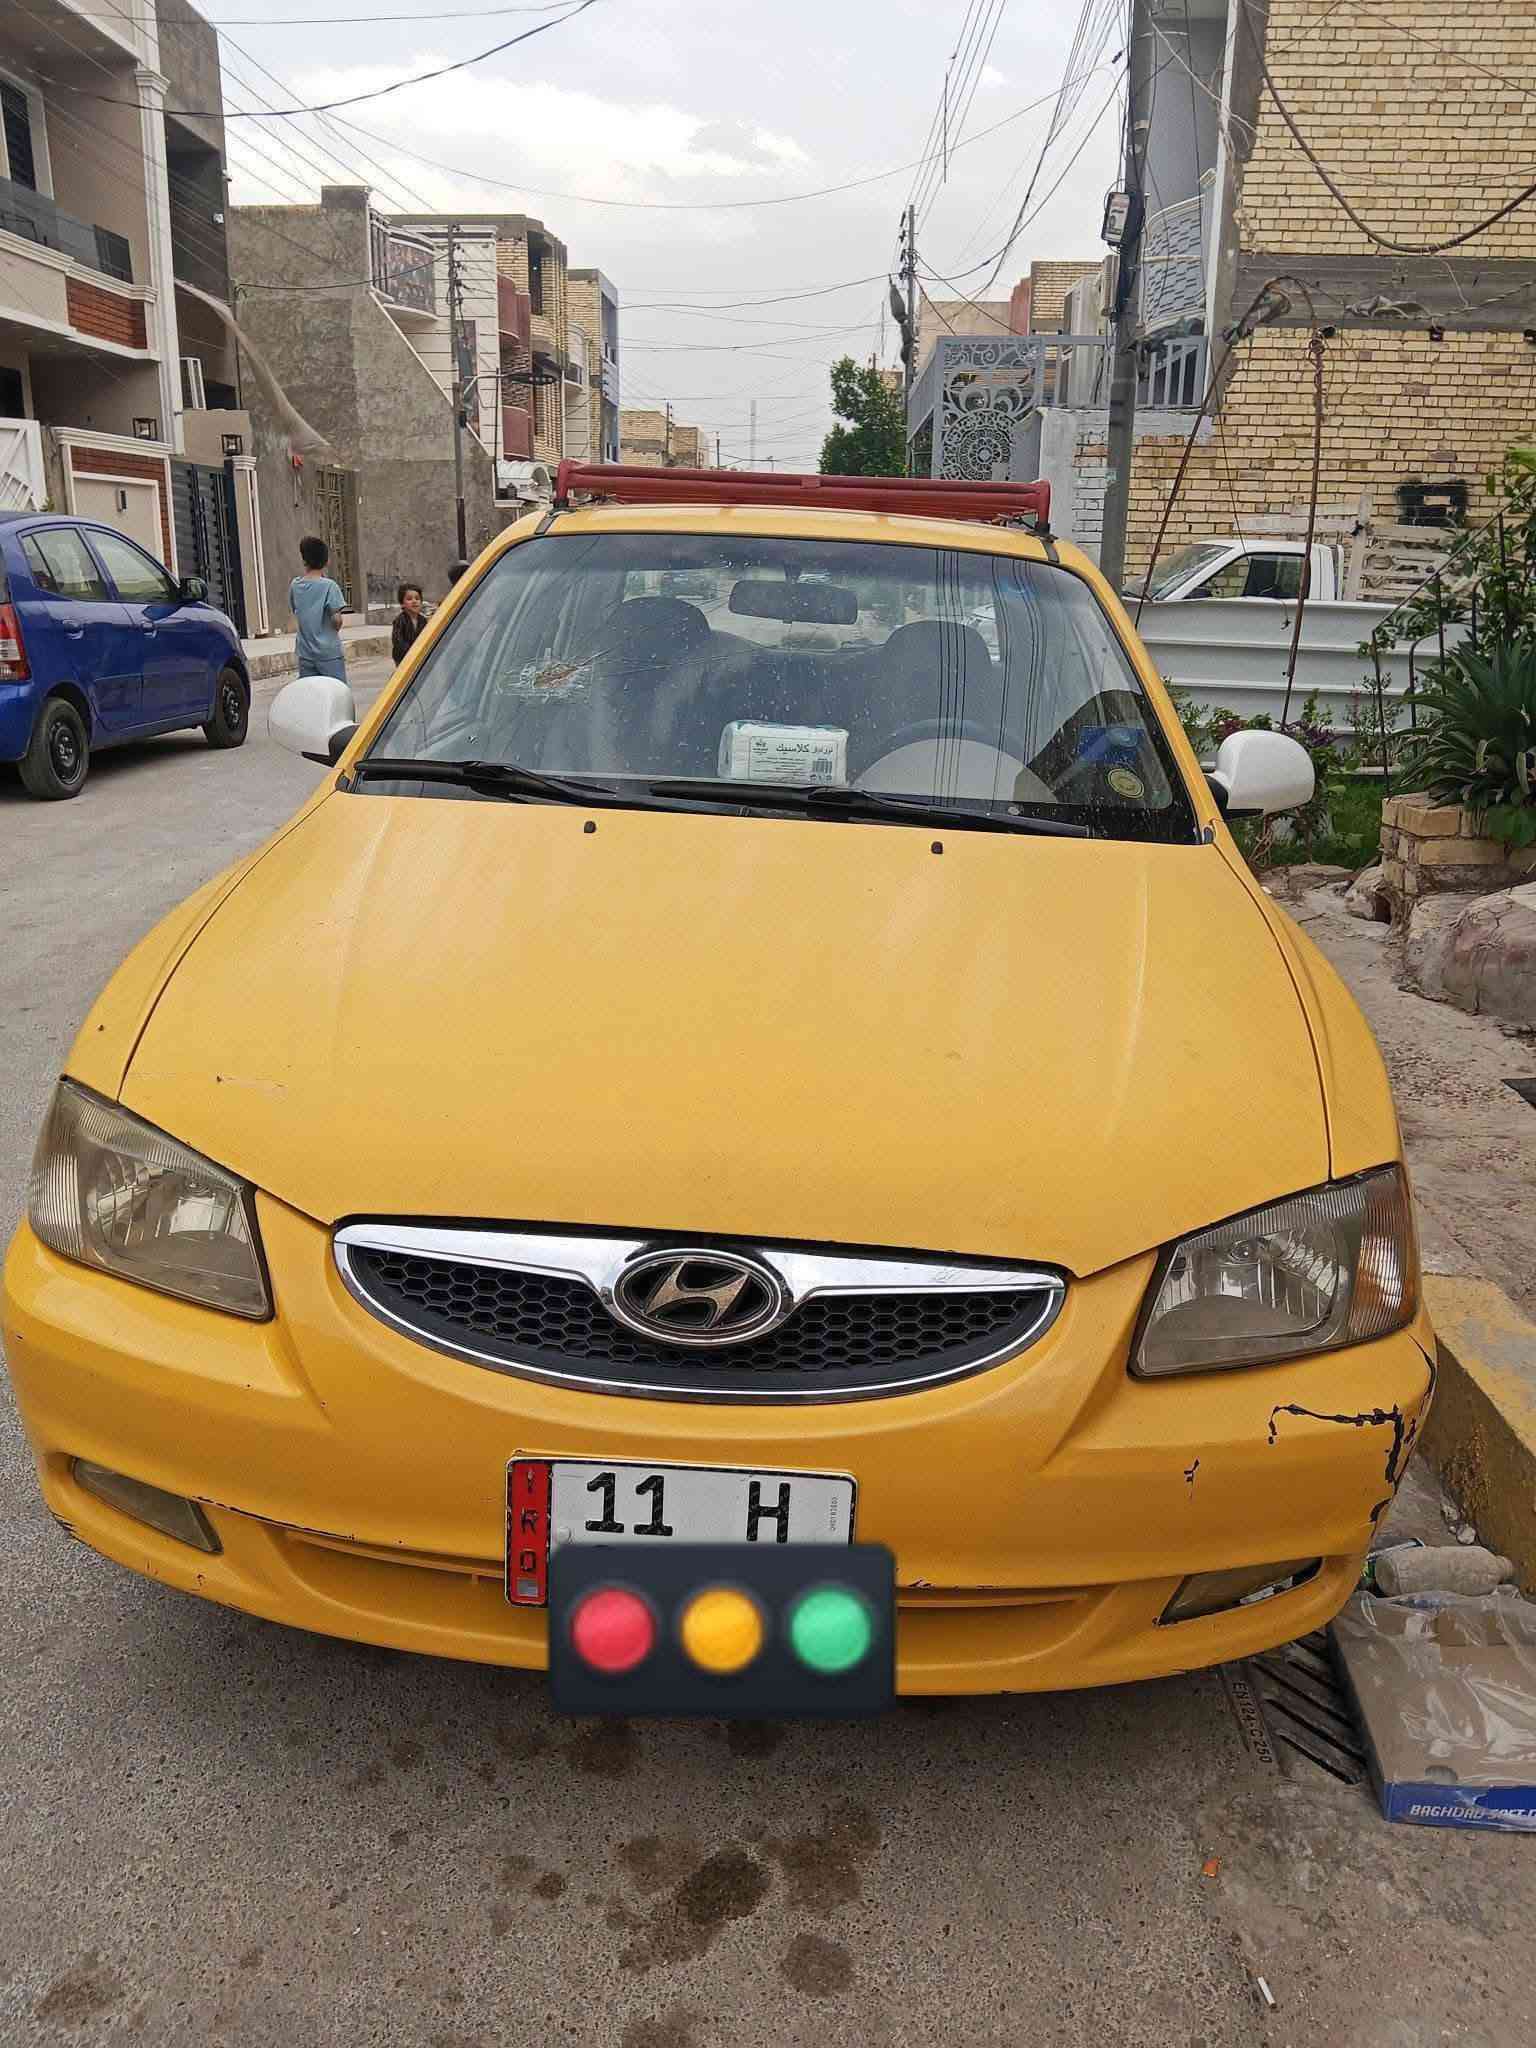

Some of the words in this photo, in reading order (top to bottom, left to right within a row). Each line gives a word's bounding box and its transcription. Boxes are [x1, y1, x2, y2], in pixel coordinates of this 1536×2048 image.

[585, 1472, 673, 1536] 11
[746, 1480, 791, 1544] H
[1410, 1804, 1485, 1819] BAGHDAD
